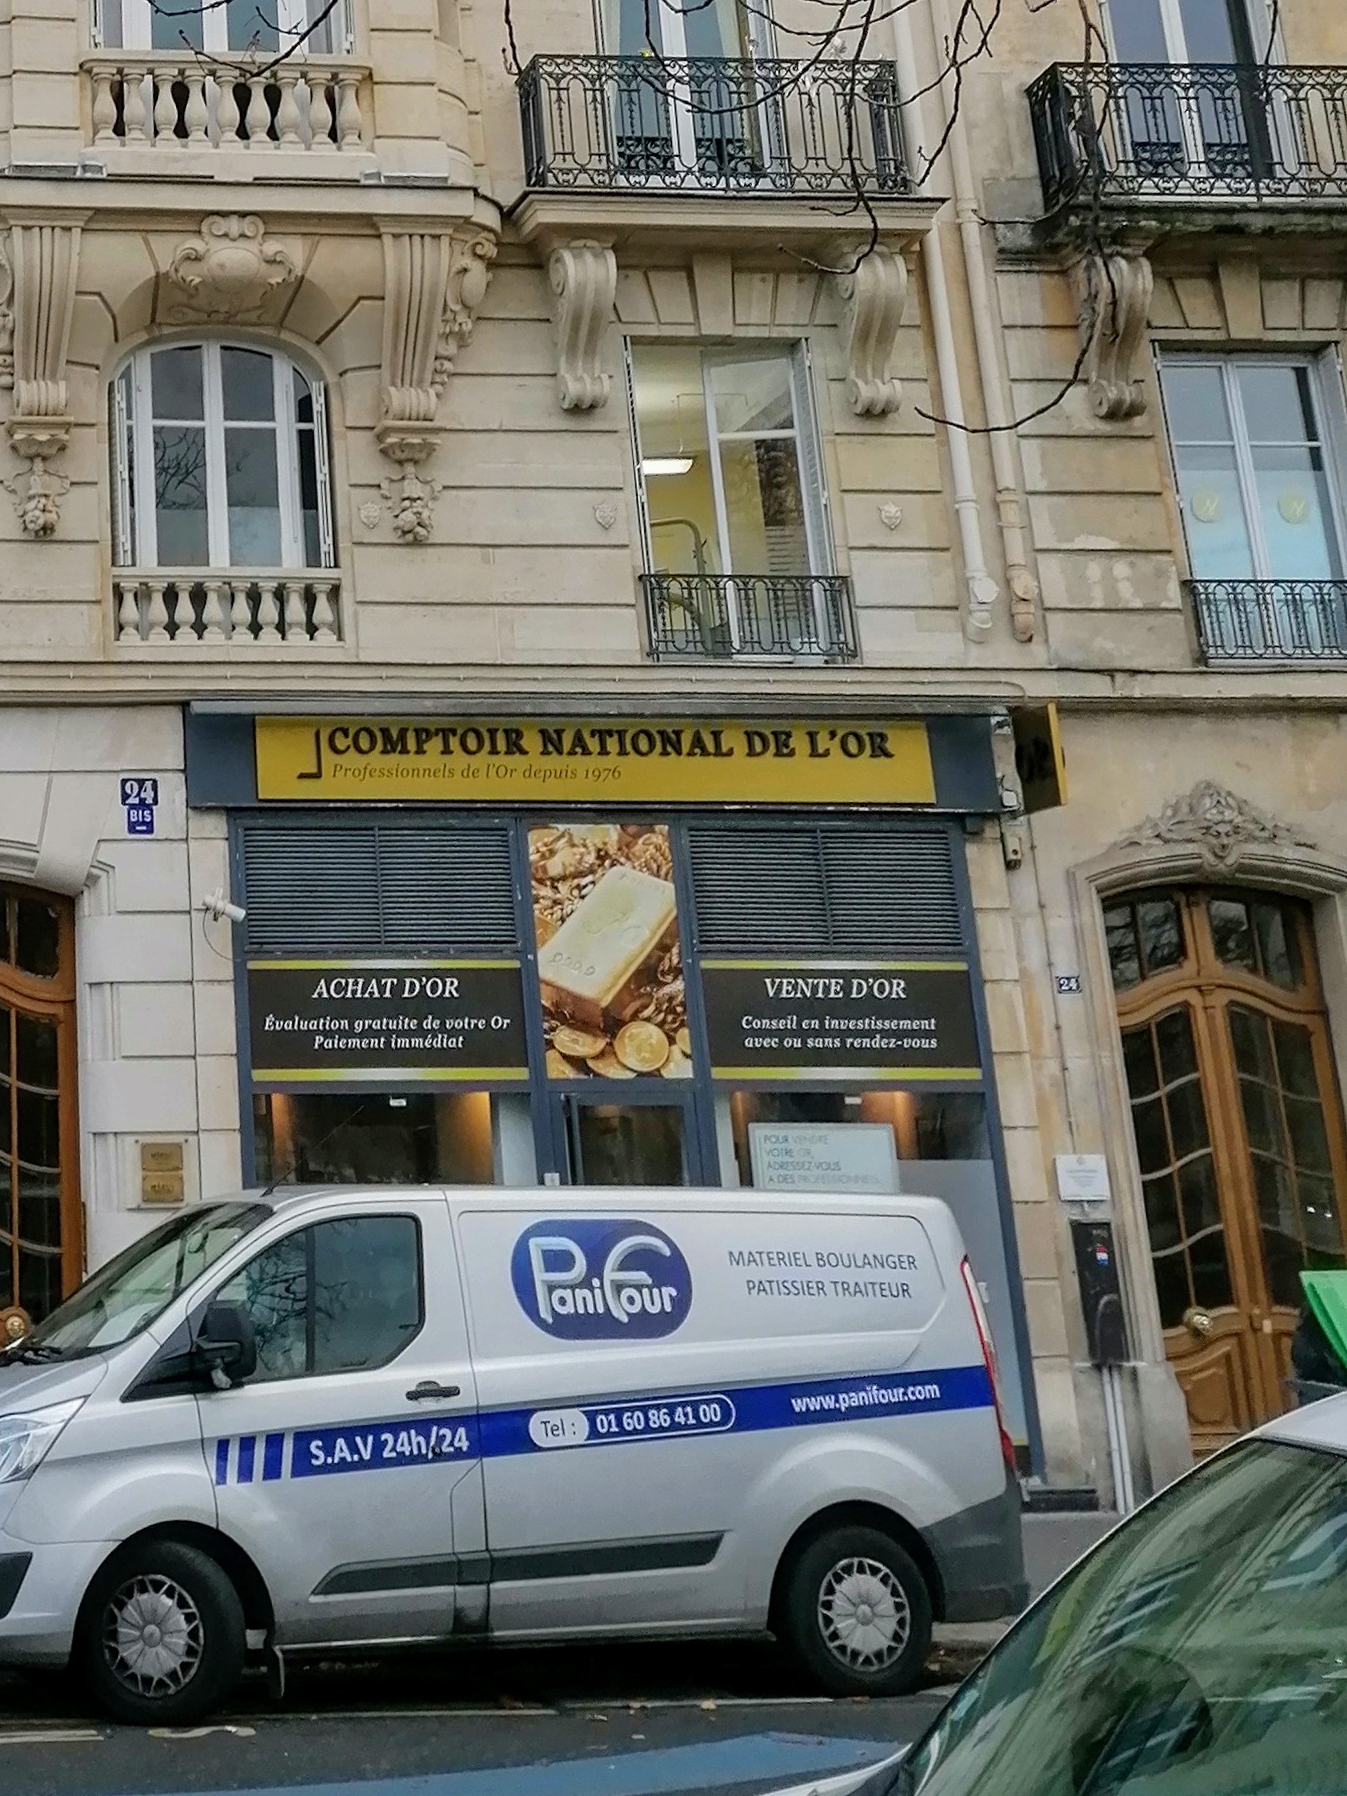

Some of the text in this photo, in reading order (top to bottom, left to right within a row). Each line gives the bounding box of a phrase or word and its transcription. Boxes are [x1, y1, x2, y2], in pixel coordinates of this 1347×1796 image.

[328, 726, 895, 760] COMPTOIR NATIONAL DE L'OR
[332, 762, 622, 783] Professionnels de l'Or depuis 1976
[125, 780, 154, 804] 24
[130, 809, 152, 822] BIS
[311, 977, 460, 999] ACHAT D'OR
[764, 978, 907, 999] VENTE D'OR
[1059, 977, 1079, 992] 24
[264, 1013, 511, 1034] Évaluation gratuite de votre Or
[741, 1014, 937, 1031] Conseil en investissement
[313, 1034, 465, 1050] Paiement immédiat
[744, 1033, 938, 1049] avec ou sans rendez-vous
[764, 1134, 789, 1145] POUR
[765, 1148, 794, 1158] VOTRE
[777, 1174, 795, 1184] DES
[728, 1250, 918, 1270] MATERIEL BOULANGER
[746, 1279, 912, 1299] PATISSIER TRAITEUR
[791, 1382, 941, 1413] www.panifour.com
[540, 1420, 566, 1438] Tel
[596, 1413, 619, 1435] 01
[622, 1411, 644, 1432] 60
[648, 1409, 671, 1429] 86
[674, 1406, 696, 1426] 41
[700, 1402, 721, 1423] 00
[309, 1426, 469, 1466] S.A.V 24h/24
